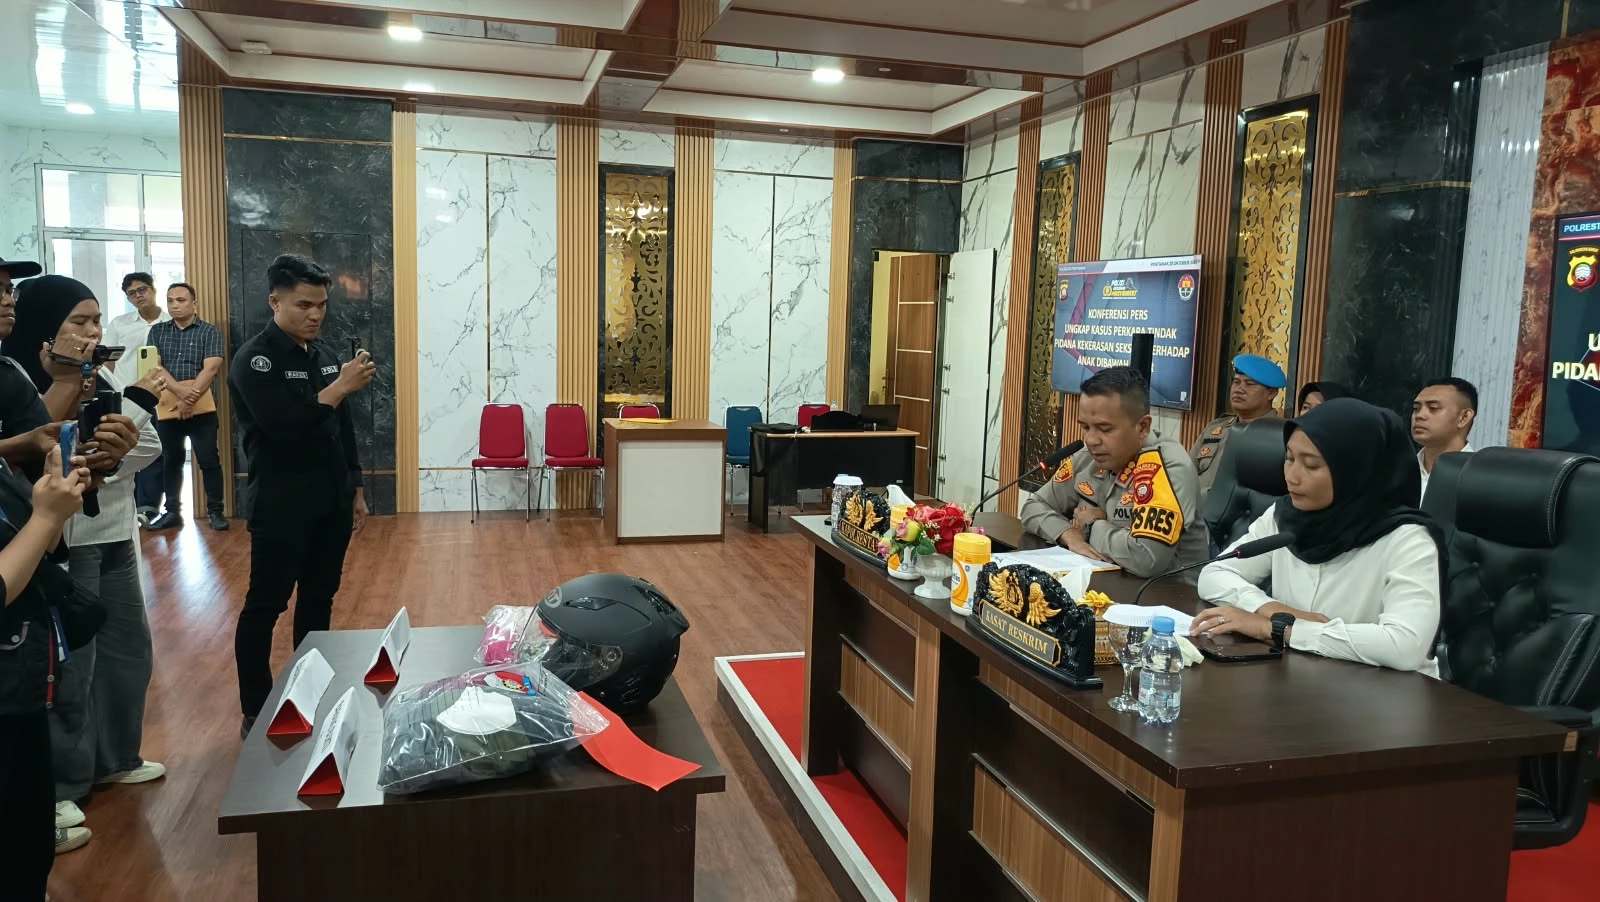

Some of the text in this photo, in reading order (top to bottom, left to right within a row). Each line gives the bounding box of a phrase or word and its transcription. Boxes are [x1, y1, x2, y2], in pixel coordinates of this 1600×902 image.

[1088, 308, 1148, 320] KONFERENSI PERS
[1064, 323, 1090, 334] UNGKAP
[1091, 325, 1112, 336] KASUS
[1147, 327, 1177, 339] TINDAK
[1054, 338, 1076, 349] PIDANA
[1077, 340, 1114, 353] KEKERASAN
[1152, 346, 1190, 358] ERHADAP
[1077, 355, 1096, 367] ANAK
[1551, 361, 1600, 381] PIDA
[1143, 506, 1175, 536] RES
[841, 521, 876, 552] KAPOLRESTA
[986, 610, 1049, 655] KASAT RESKRIM
